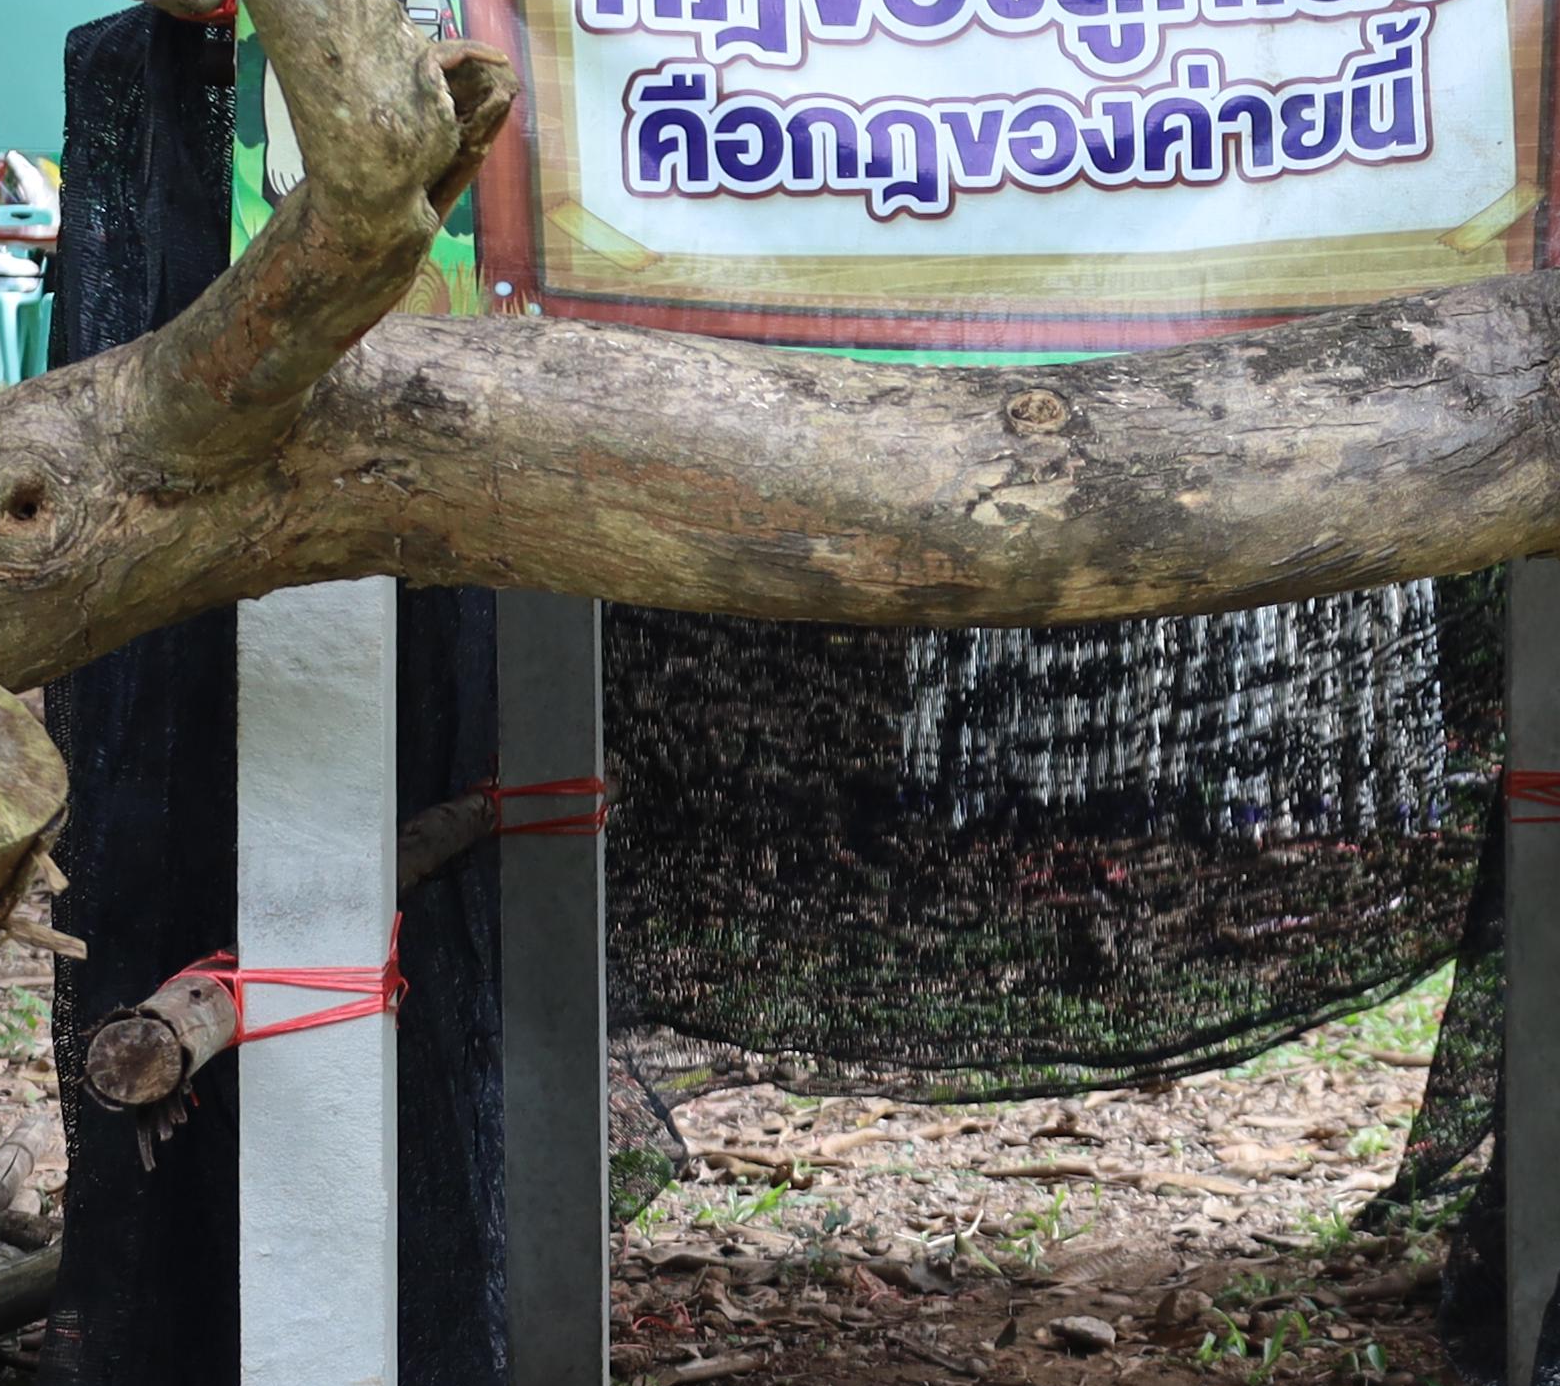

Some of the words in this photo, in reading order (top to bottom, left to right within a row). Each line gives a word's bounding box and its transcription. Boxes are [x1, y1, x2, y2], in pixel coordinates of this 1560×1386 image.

[638, 15, 1418, 205] คือกฎของค่ายนี้
